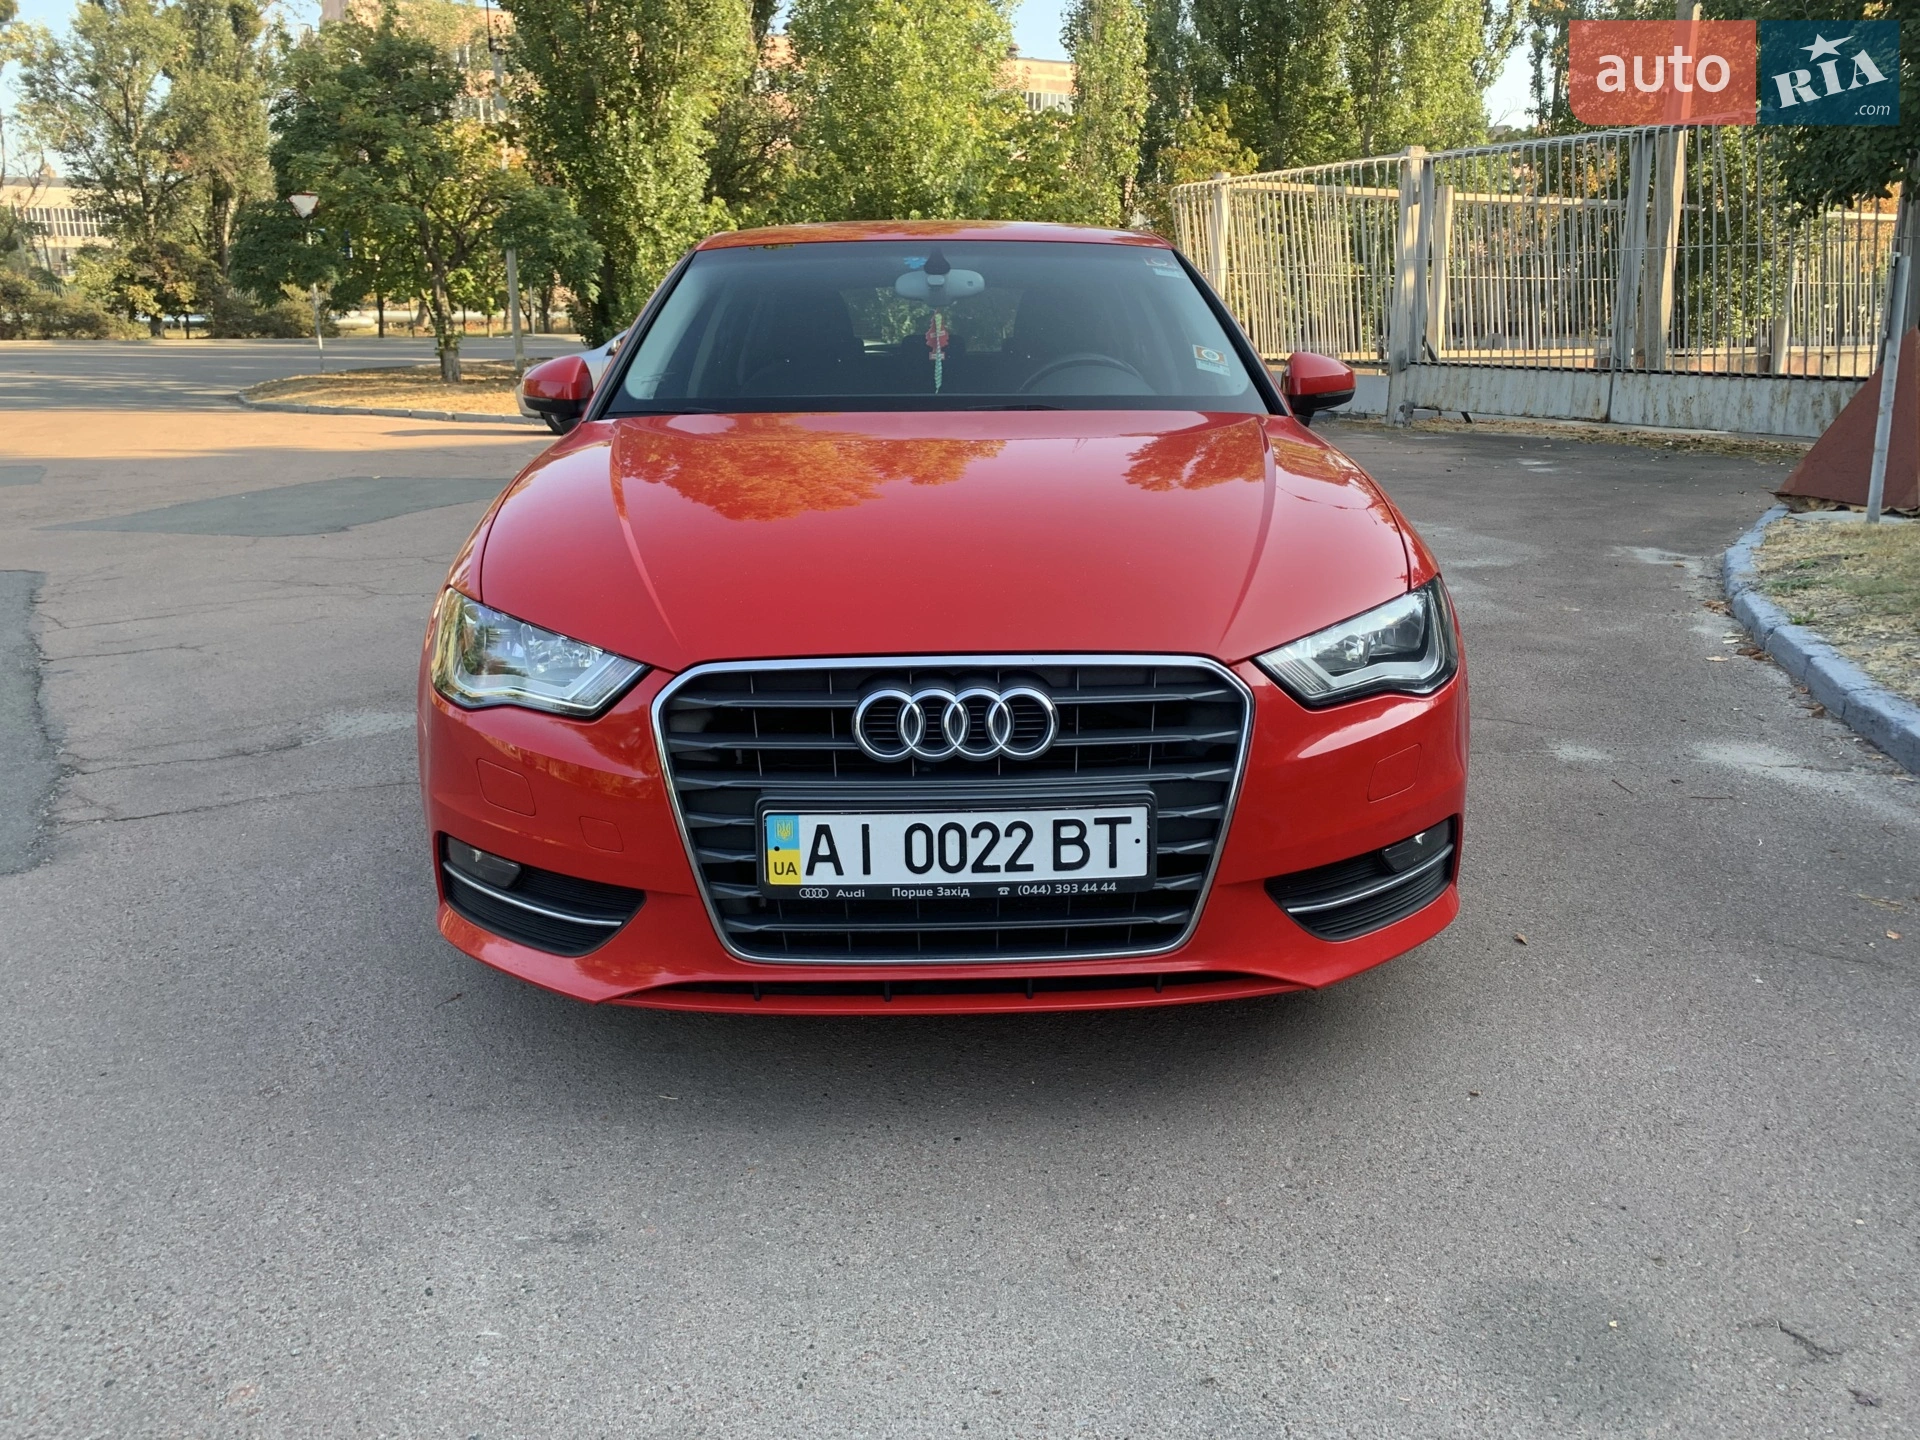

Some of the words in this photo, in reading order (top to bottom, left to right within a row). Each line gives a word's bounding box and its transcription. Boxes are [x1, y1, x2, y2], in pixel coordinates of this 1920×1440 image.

[805, 823, 871, 876] AI
[904, 821, 1034, 874] 0022
[1052, 816, 1132, 872] BT
[773, 862, 798, 876] UA
[836, 889, 865, 898] Audi
[892, 887, 934, 899] Порше
[936, 886, 970, 897] Захід
[1017, 884, 1051, 896] (044)
[1054, 883, 1079, 894] 393
[1081, 883, 1098, 893] 44
[1100, 882, 1117, 892] 44
